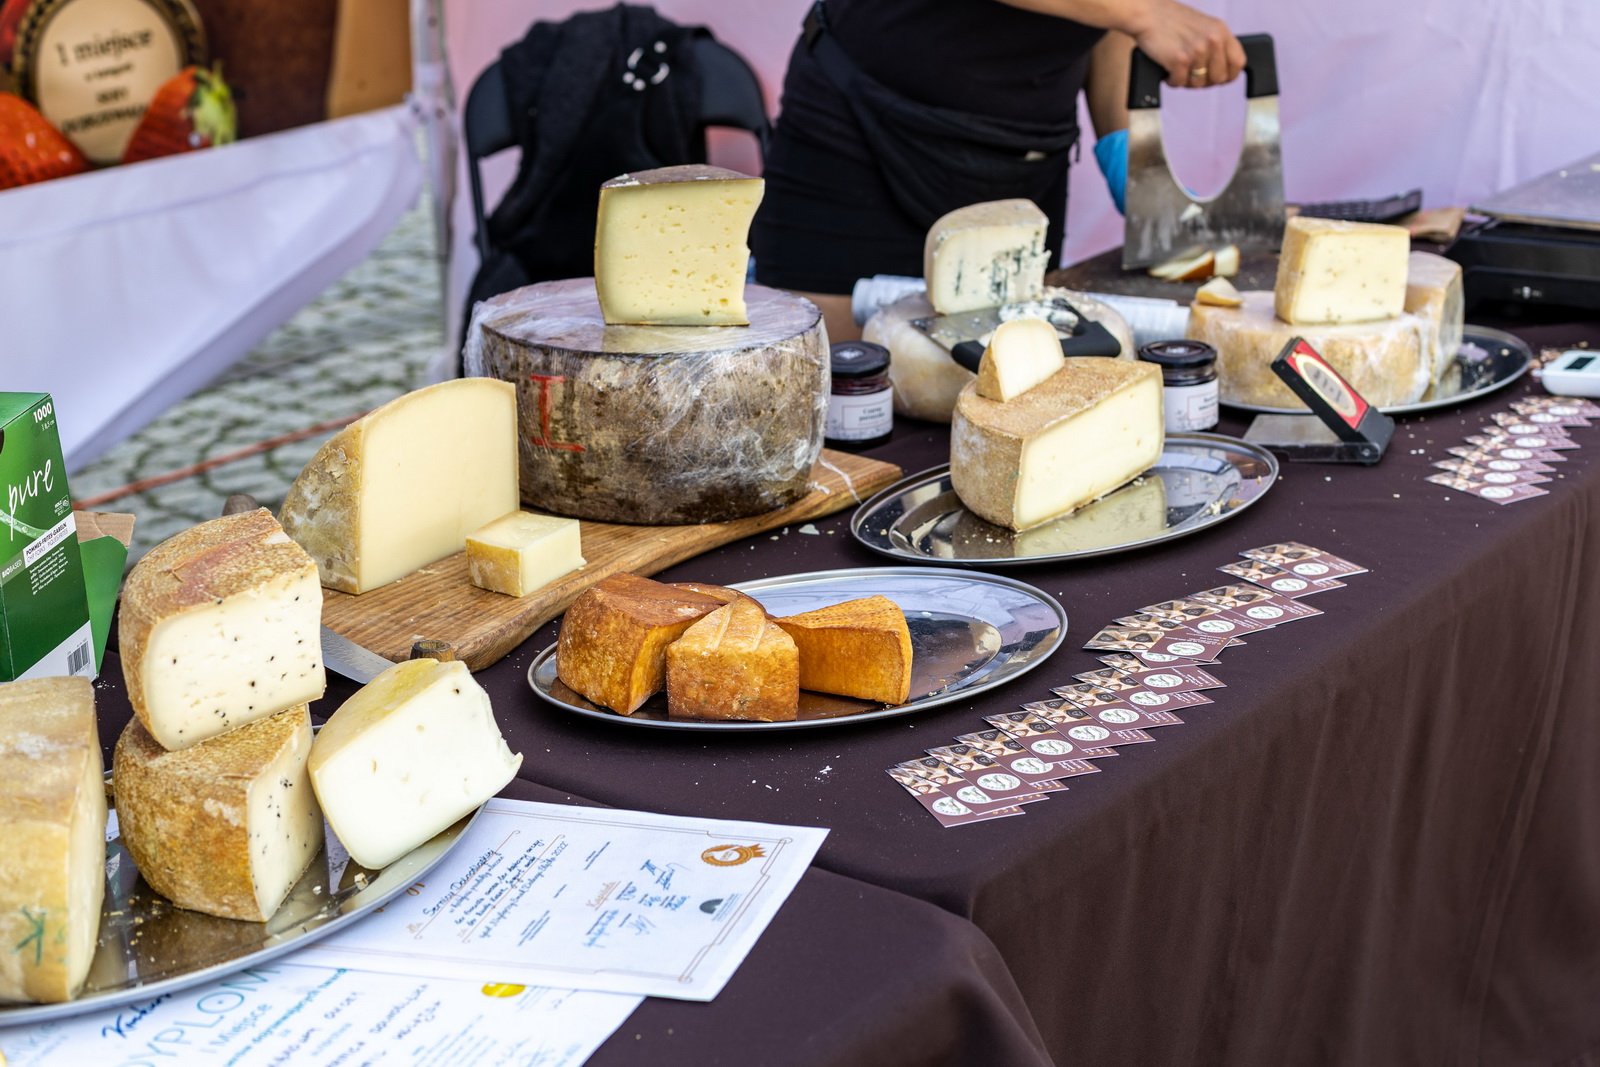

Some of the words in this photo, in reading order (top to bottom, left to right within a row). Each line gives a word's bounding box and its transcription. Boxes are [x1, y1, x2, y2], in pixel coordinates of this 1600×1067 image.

[73, 29, 153, 60] miejsce
[33, 402, 52, 423] 1000
[9, 458, 54, 541] pure
[117, 967, 281, 1067] YPLOM
